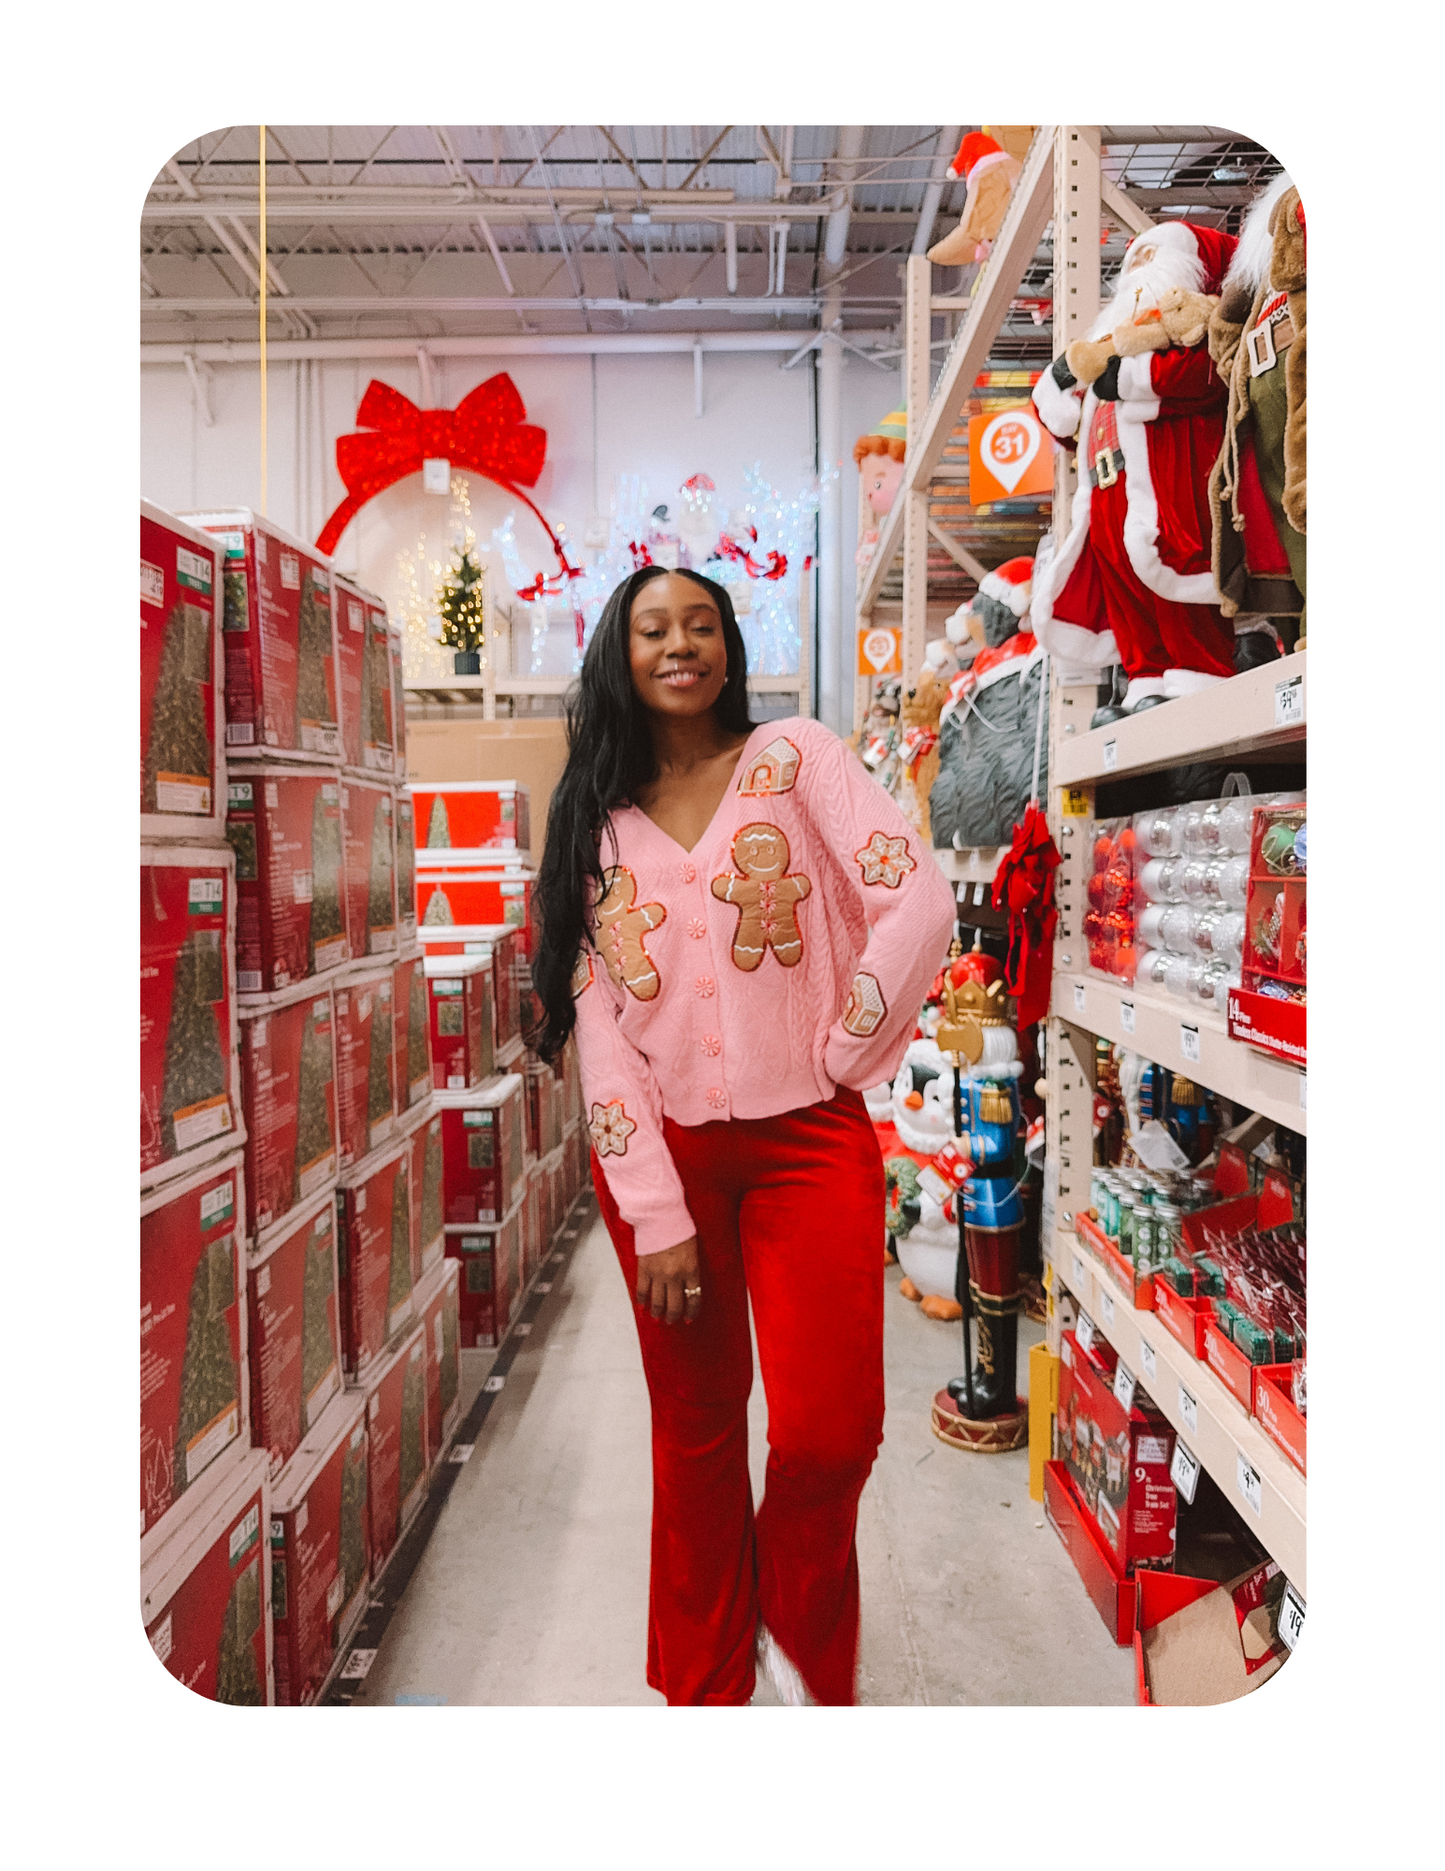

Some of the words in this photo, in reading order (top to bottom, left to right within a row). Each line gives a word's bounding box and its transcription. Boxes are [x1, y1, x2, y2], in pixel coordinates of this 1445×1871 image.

[995, 433, 1024, 460] 31
[232, 786, 250, 799] T9
[1134, 1466, 1146, 1483] 9
